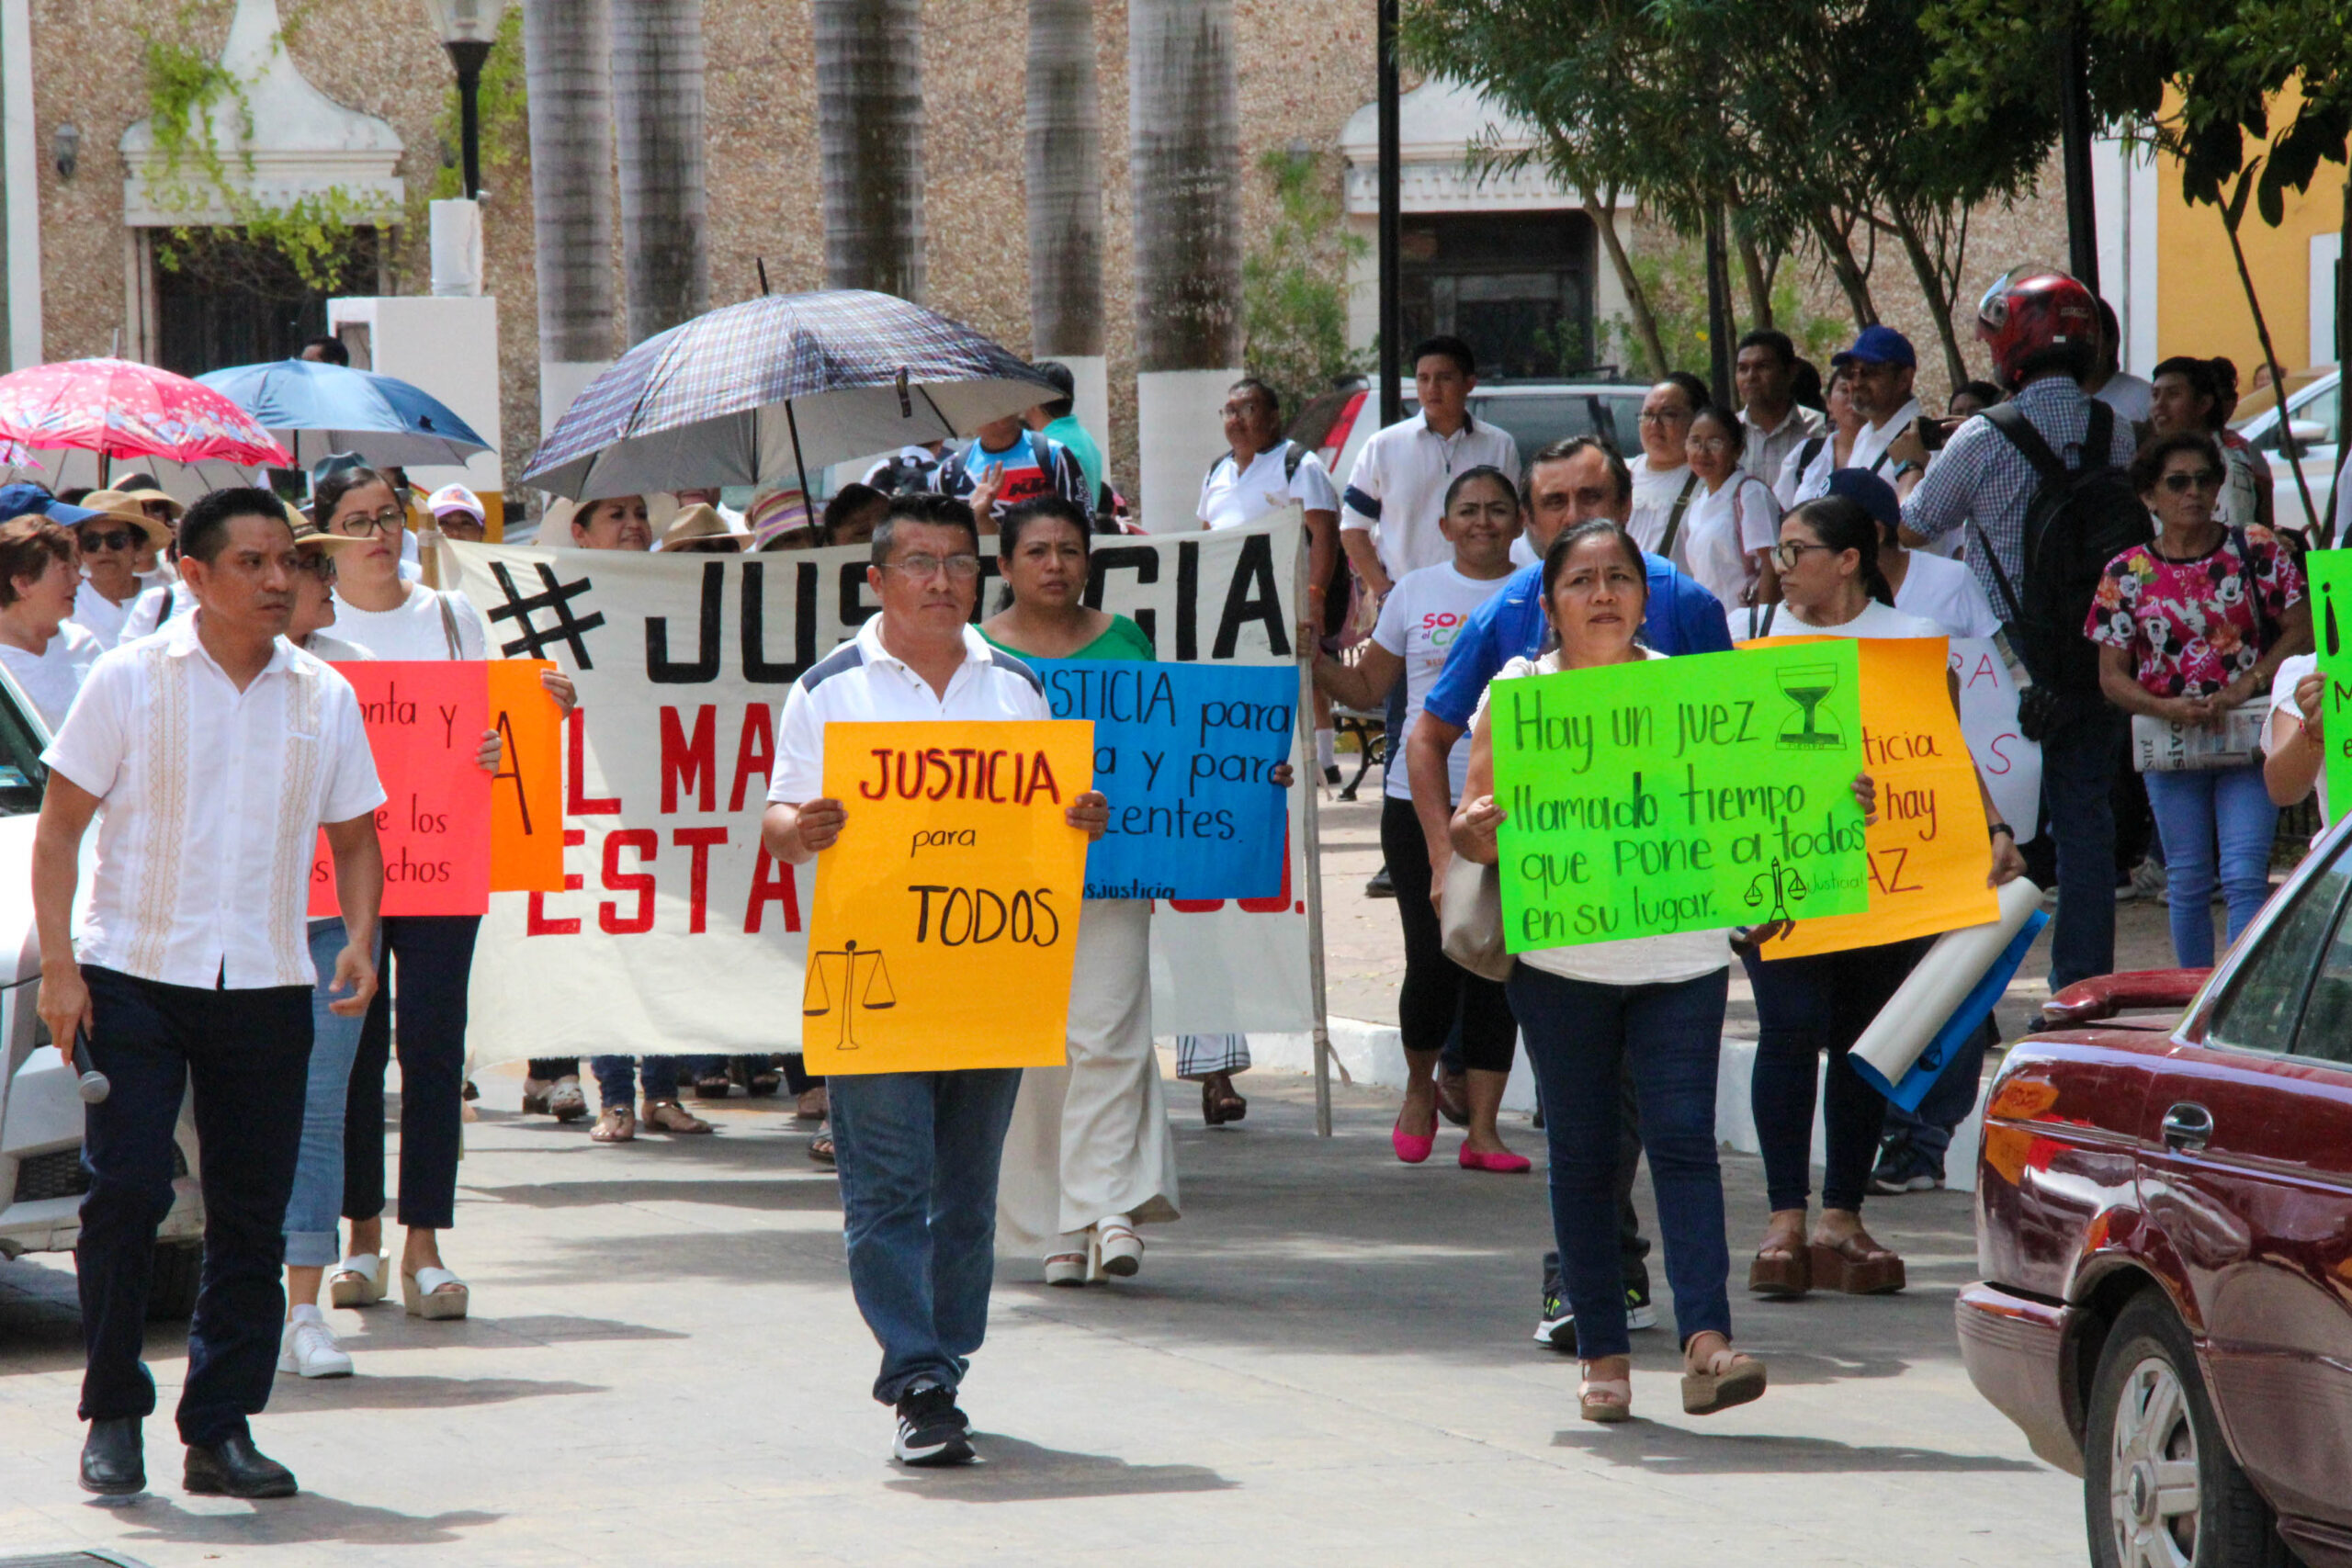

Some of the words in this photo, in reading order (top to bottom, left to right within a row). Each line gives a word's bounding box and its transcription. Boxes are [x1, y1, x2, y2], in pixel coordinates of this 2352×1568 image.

[1201, 701, 1291, 749] para
[1514, 689, 1594, 774] Hay
[1611, 705, 1654, 748] un
[859, 747, 1062, 807] JUSTICIA
[1142, 750, 1166, 792] y
[1513, 771, 1658, 833] llamado
[1680, 762, 1806, 826] tiempo
[413, 793, 447, 833] los
[1886, 783, 1938, 841] hay
[910, 829, 977, 858] para
[1521, 850, 1590, 900] que
[1732, 831, 1762, 865] a
[1772, 811, 1866, 863] todos
[907, 885, 1059, 947] TODOS
[1634, 886, 1718, 934] lugar.
